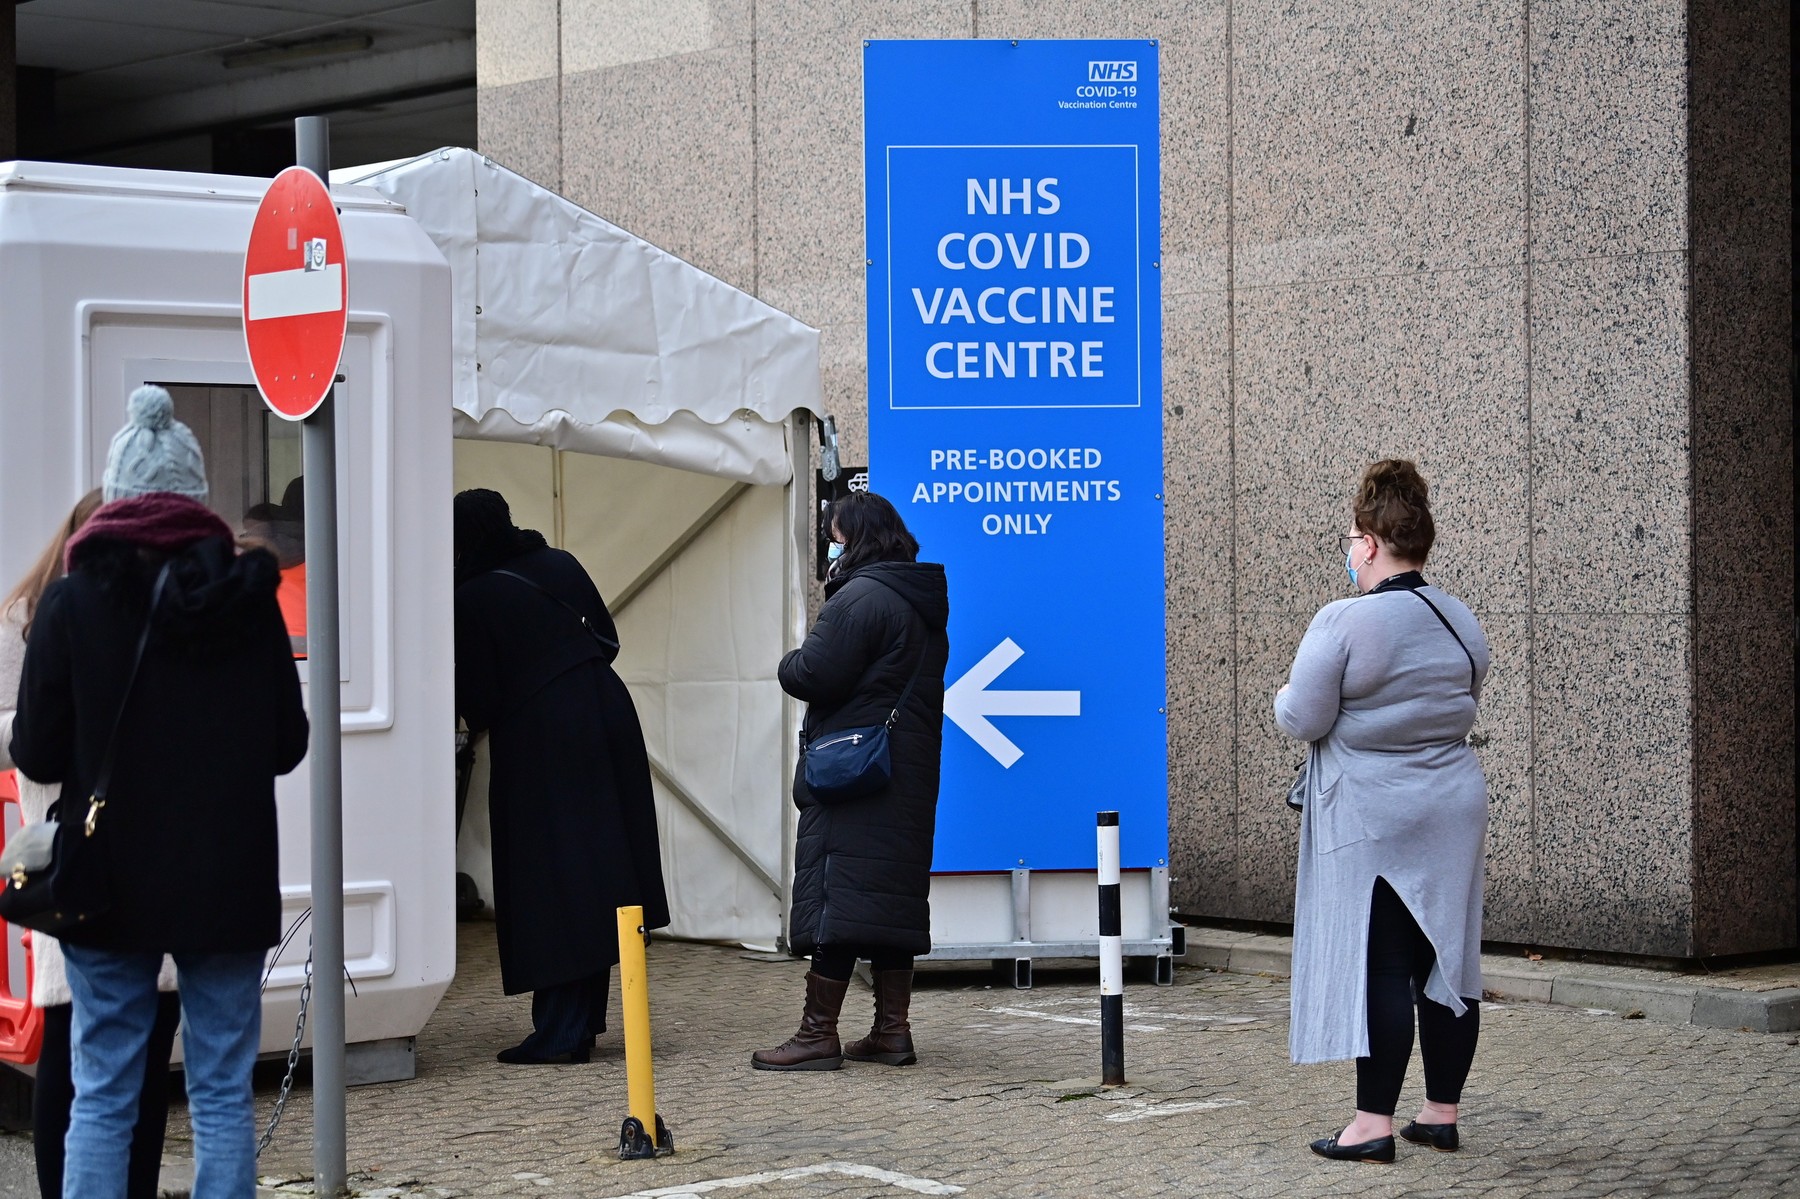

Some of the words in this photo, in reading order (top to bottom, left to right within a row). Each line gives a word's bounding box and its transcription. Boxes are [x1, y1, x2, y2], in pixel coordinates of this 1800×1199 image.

[1090, 63, 1135, 80] NHS
[1076, 85, 1137, 98] COVID-19
[1058, 100, 1107, 109] Vaccination
[1109, 100, 1138, 109] Centre
[967, 177, 1061, 215] NHS
[937, 232, 1090, 270] COVID
[911, 286, 1115, 325] VACCINE
[925, 341, 1104, 379] CENTRE
[931, 448, 1102, 471] PRE-BOOKED
[911, 480, 1121, 504] APPOINTMENTS
[982, 513, 1052, 536] ONLY
